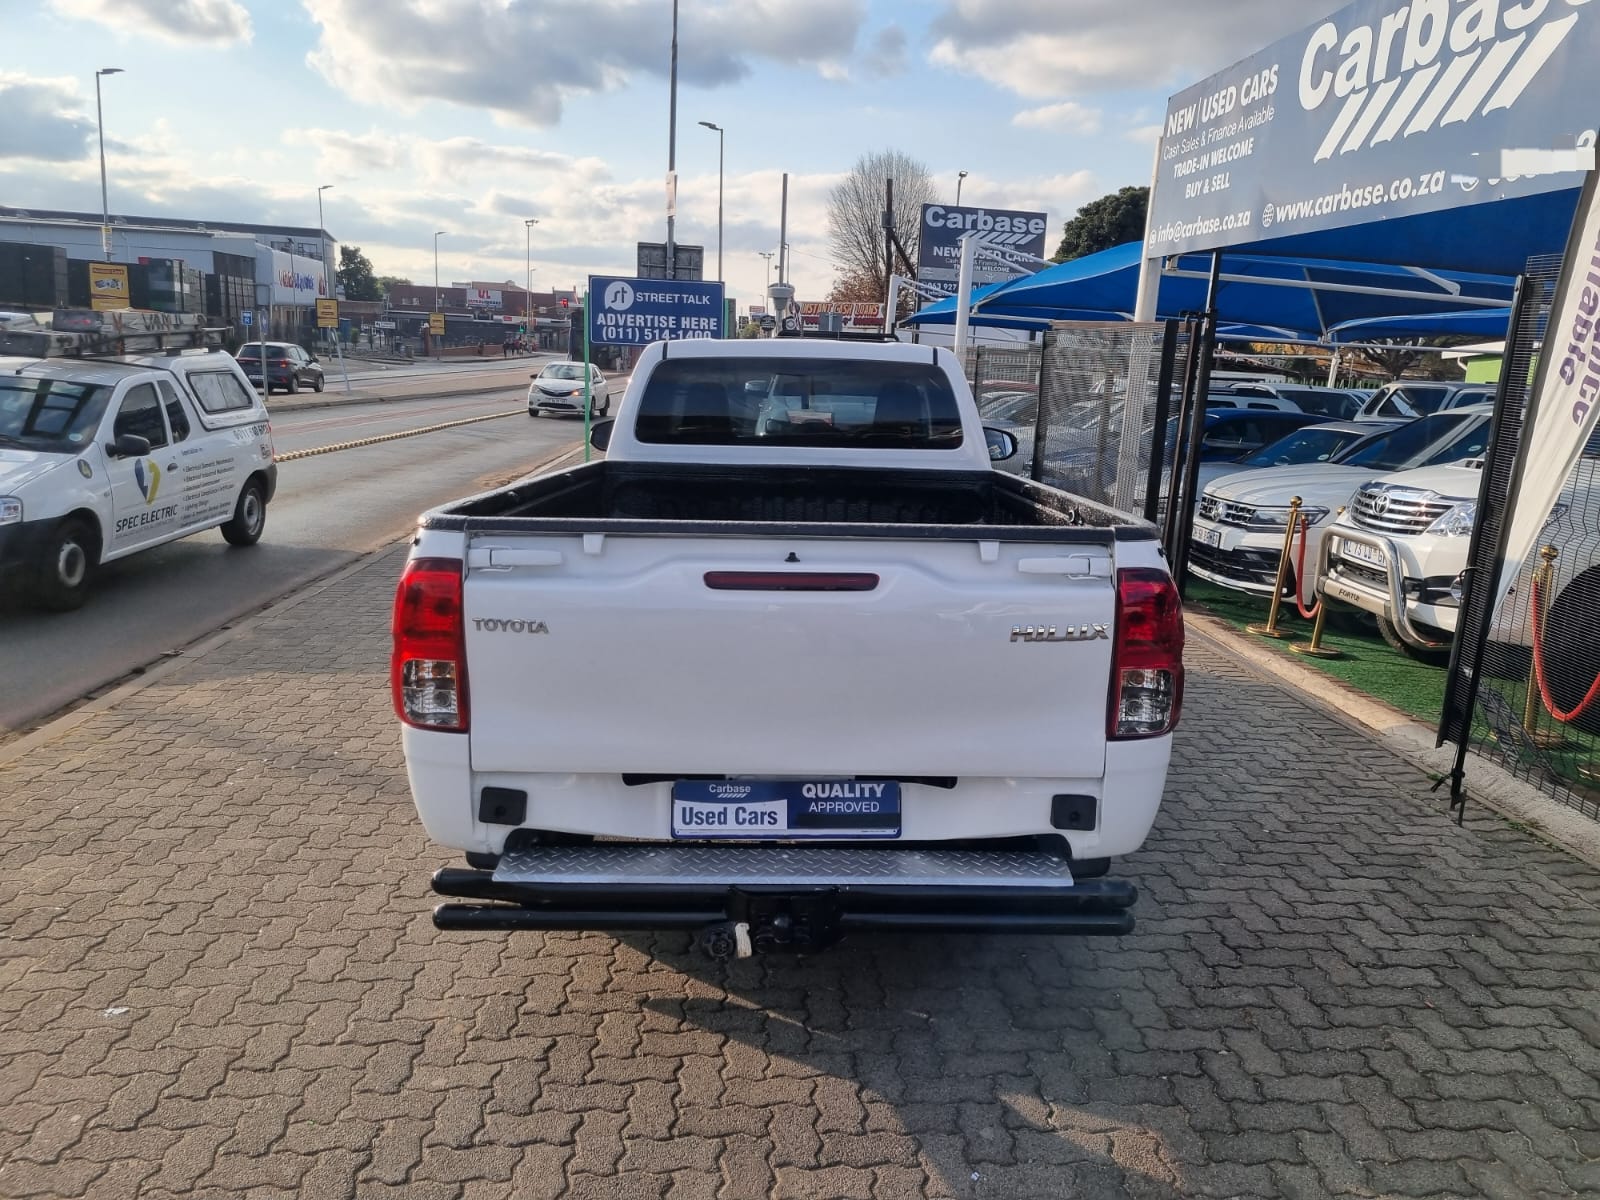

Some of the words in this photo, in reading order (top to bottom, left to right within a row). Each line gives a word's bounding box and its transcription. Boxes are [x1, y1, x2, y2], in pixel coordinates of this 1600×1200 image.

[1298, 0, 1592, 110] Carba
[1166, 103, 1197, 138] NEW
[1201, 85, 1237, 123] USED
[1240, 63, 1280, 107] CARS
[1163, 142, 1180, 161] Cash
[1180, 135, 1200, 154] Sales
[1200, 130, 1206, 148] &
[1207, 122, 1237, 145] Finance
[1237, 104, 1275, 134] Available
[1173, 153, 1210, 180] TRADE-IN
[1210, 137, 1255, 167] WELCOME
[1185, 180, 1203, 200] BUY
[1202, 178, 1210, 195] &
[1211, 171, 1231, 193] SELL
[1275, 169, 1446, 224] www.carbase.co.za
[925, 206, 1045, 235] Carbase
[1157, 209, 1252, 242] info@carbase.co.za
[933, 246, 962, 258] NEW
[635, 291, 680, 303] STREET
[681, 294, 711, 305] TALK
[596, 312, 677, 329] ADVERTISE
[681, 316, 718, 331] HERE
[602, 325, 640, 342] (011)
[115, 515, 140, 533] SPEC
[140, 504, 179, 526] ELECTRIC
[472, 617, 549, 634] TOYOTA
[1010, 622, 1111, 643] HILUX
[708, 783, 752, 794] Carbase
[801, 783, 886, 798] QUALITY
[681, 806, 728, 826] Used
[734, 806, 778, 826] Cars
[808, 801, 880, 813] APPROVED
